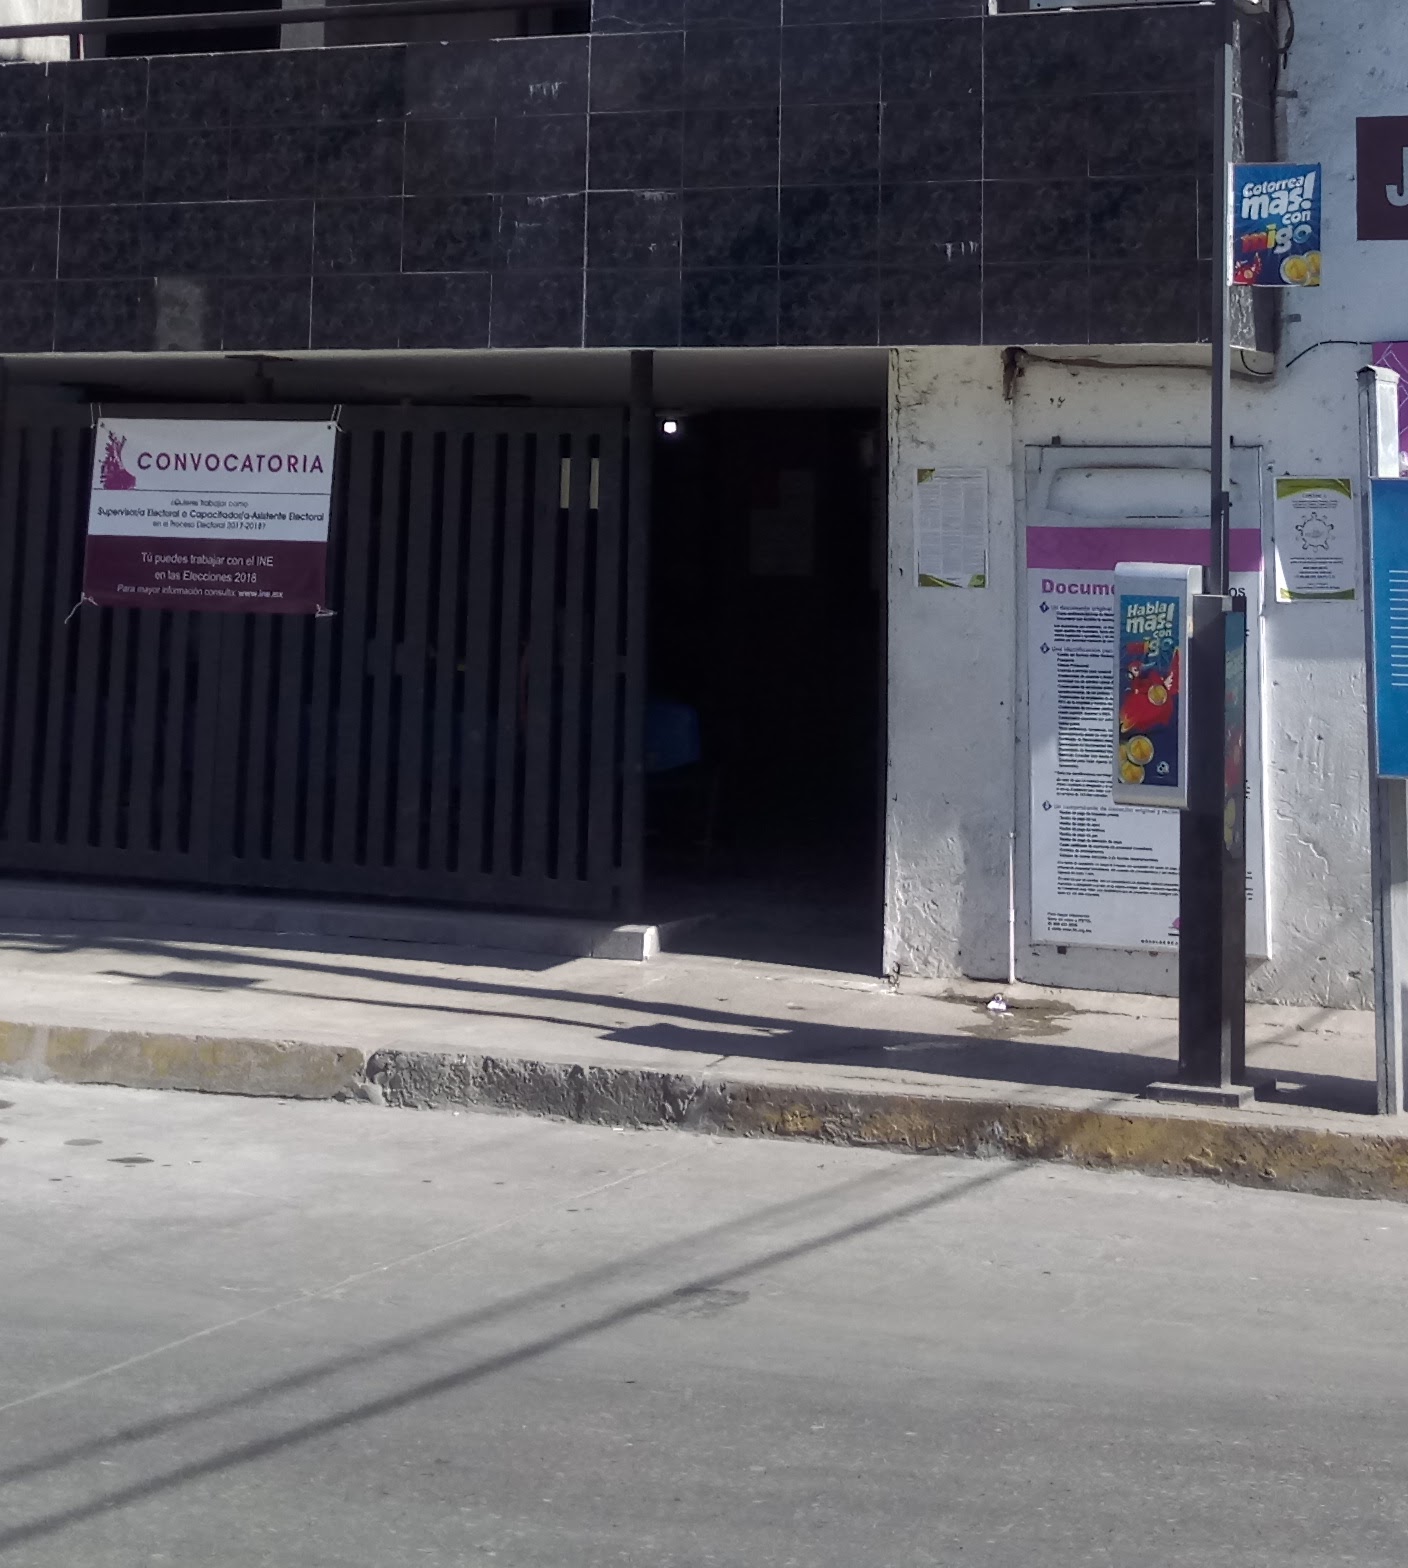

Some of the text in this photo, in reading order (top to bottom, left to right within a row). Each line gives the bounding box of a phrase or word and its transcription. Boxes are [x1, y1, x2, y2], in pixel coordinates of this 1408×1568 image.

[1242, 176, 1305, 197] Cotorrea
[1242, 171, 1316, 220] mas!
[1281, 210, 1311, 225] con
[137, 451, 324, 474] CONVOCATORIA
[141, 552, 274, 567] Tú puedes trabajar con el INE
[154, 570, 257, 583] en las Elecciones 2018
[1127, 601, 1167, 617] Habla
[1153, 629, 1172, 638] con
